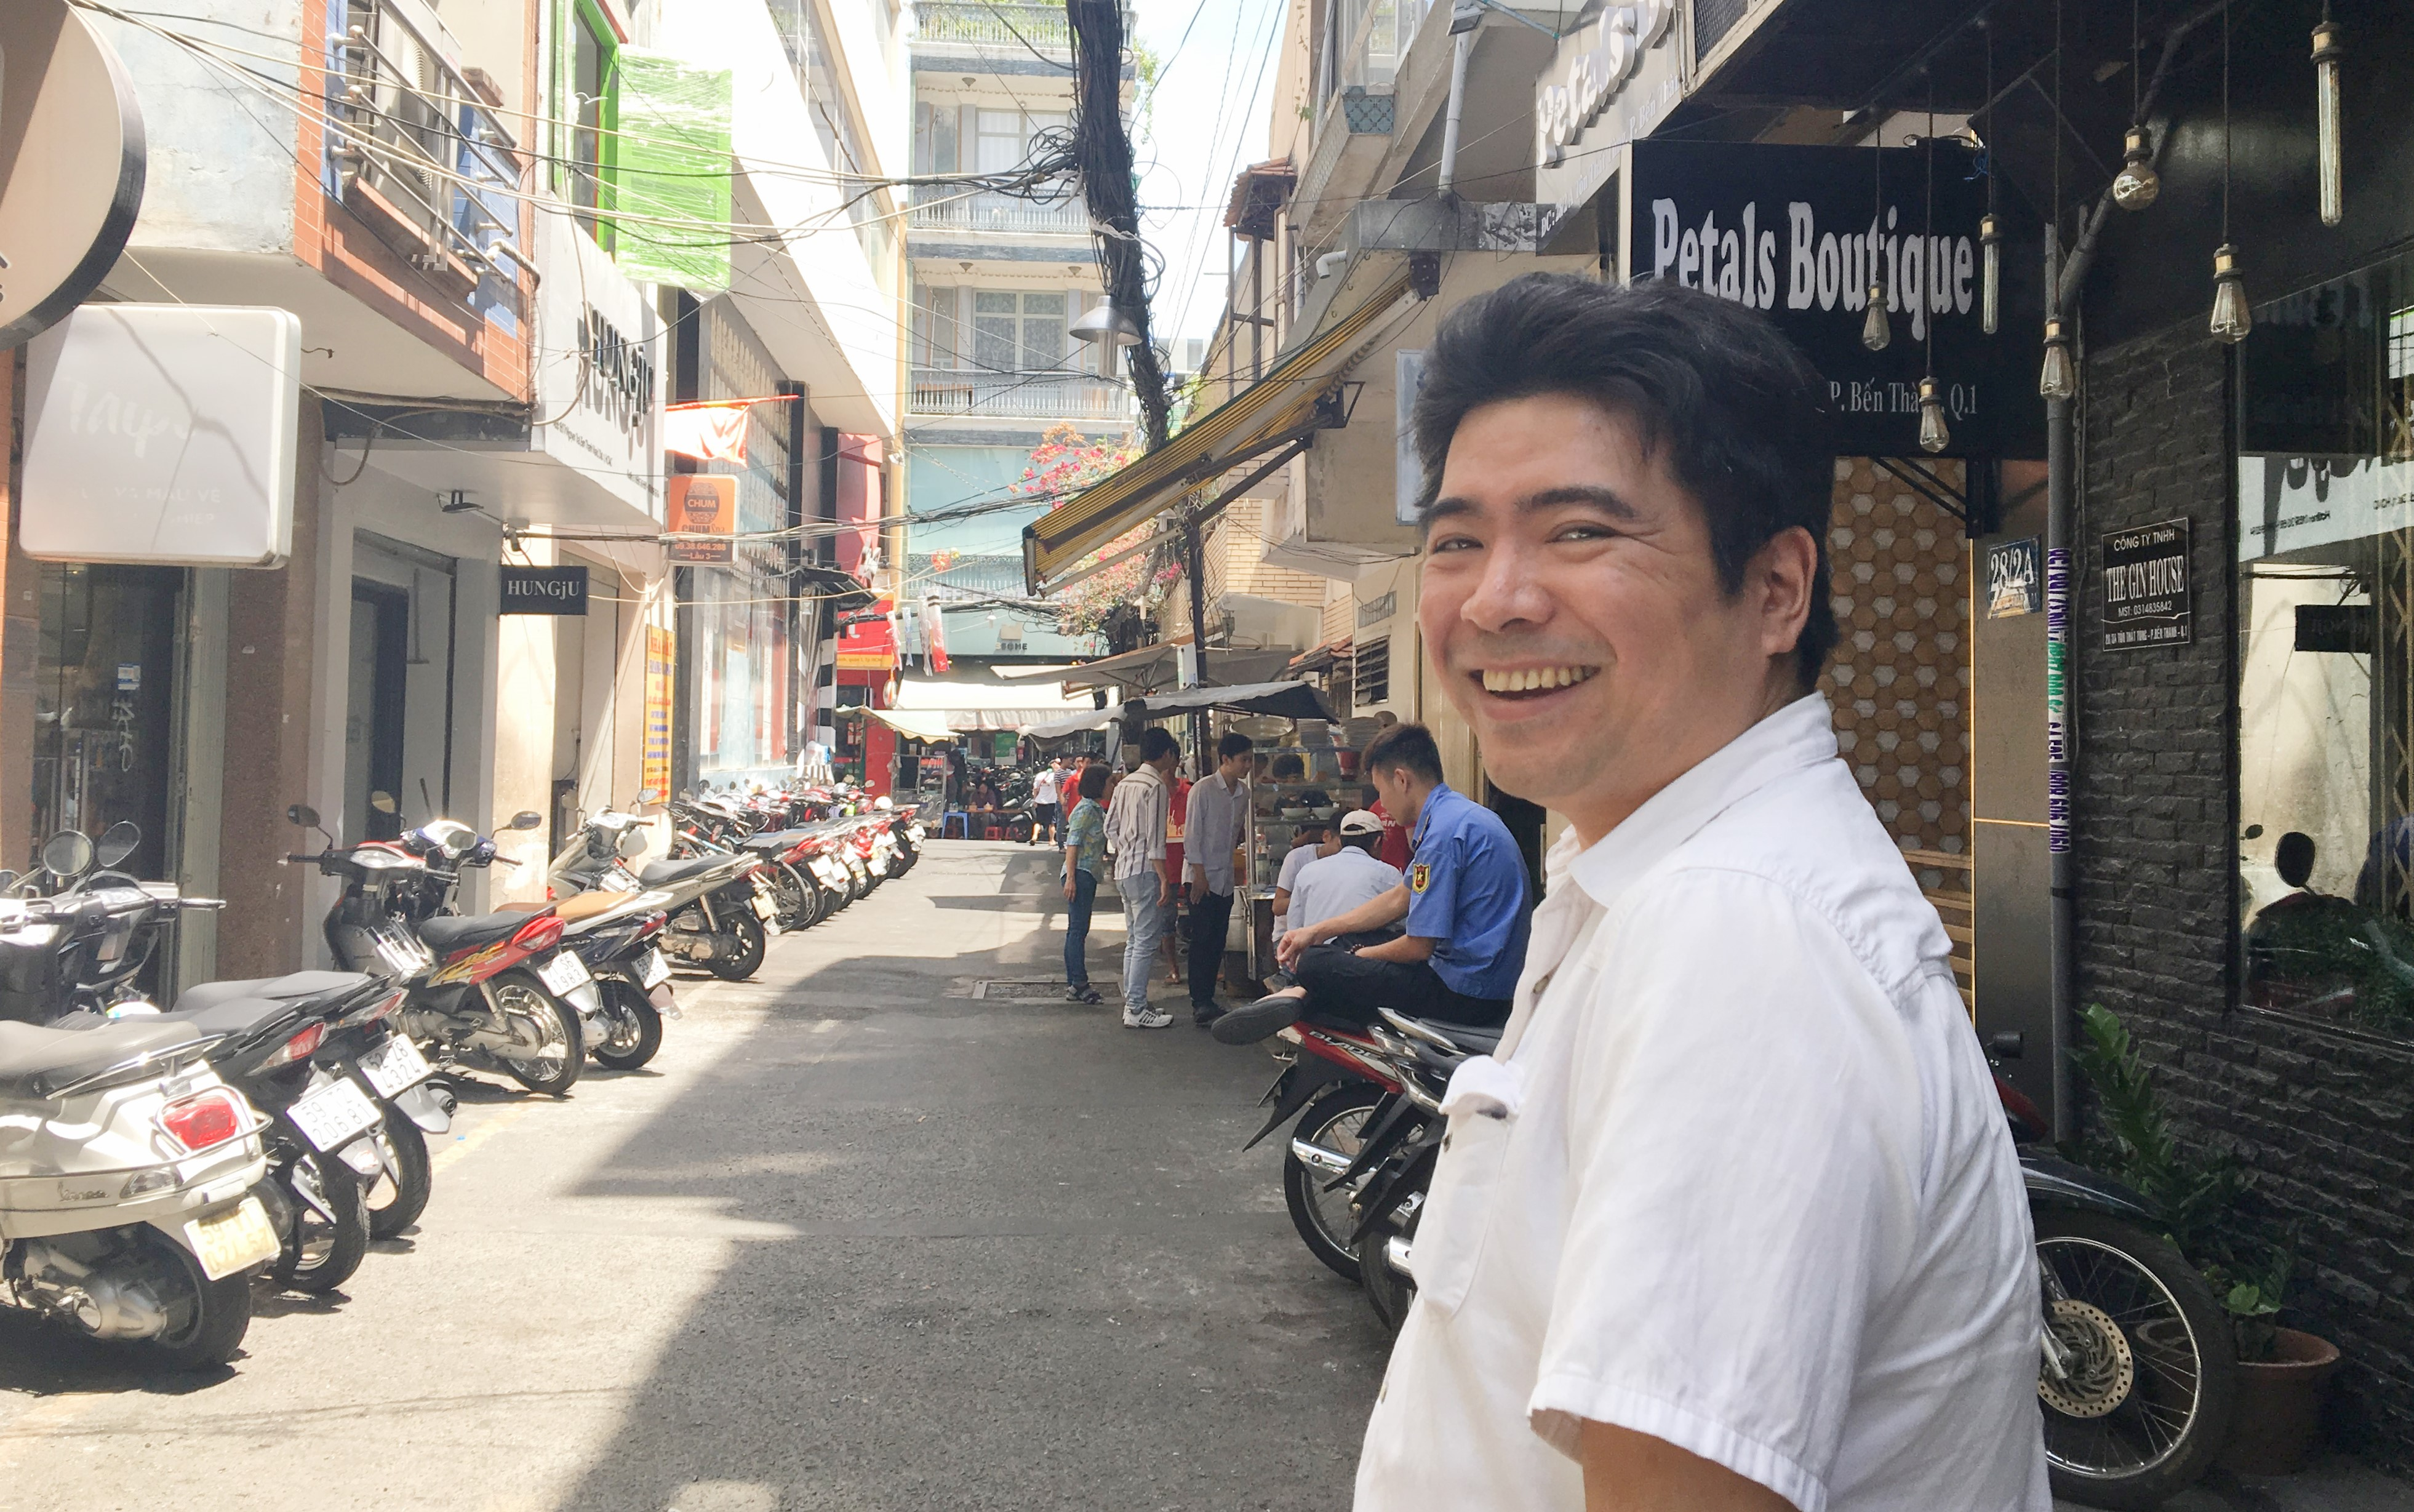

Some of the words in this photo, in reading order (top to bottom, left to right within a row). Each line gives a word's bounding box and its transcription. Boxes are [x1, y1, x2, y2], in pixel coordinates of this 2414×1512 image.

[1537, 5, 1636, 169] Petals
[1652, 198, 1776, 310] Petals
[1787, 201, 1974, 342] Boutique
[1850, 377, 1883, 412] Bến
[1950, 383, 1977, 421] Q.1
[687, 499, 717, 508] CHUM
[2114, 535, 2140, 551] CÔNG
[2141, 533, 2151, 546] TY
[2153, 528, 2175, 544] TNHH
[2106, 565, 2127, 602] THE
[2128, 561, 2146, 600] GIN
[2149, 555, 2184, 597] HOUSE
[2118, 606, 2133, 617] MST:
[381, 1060, 422, 1090] 4324
